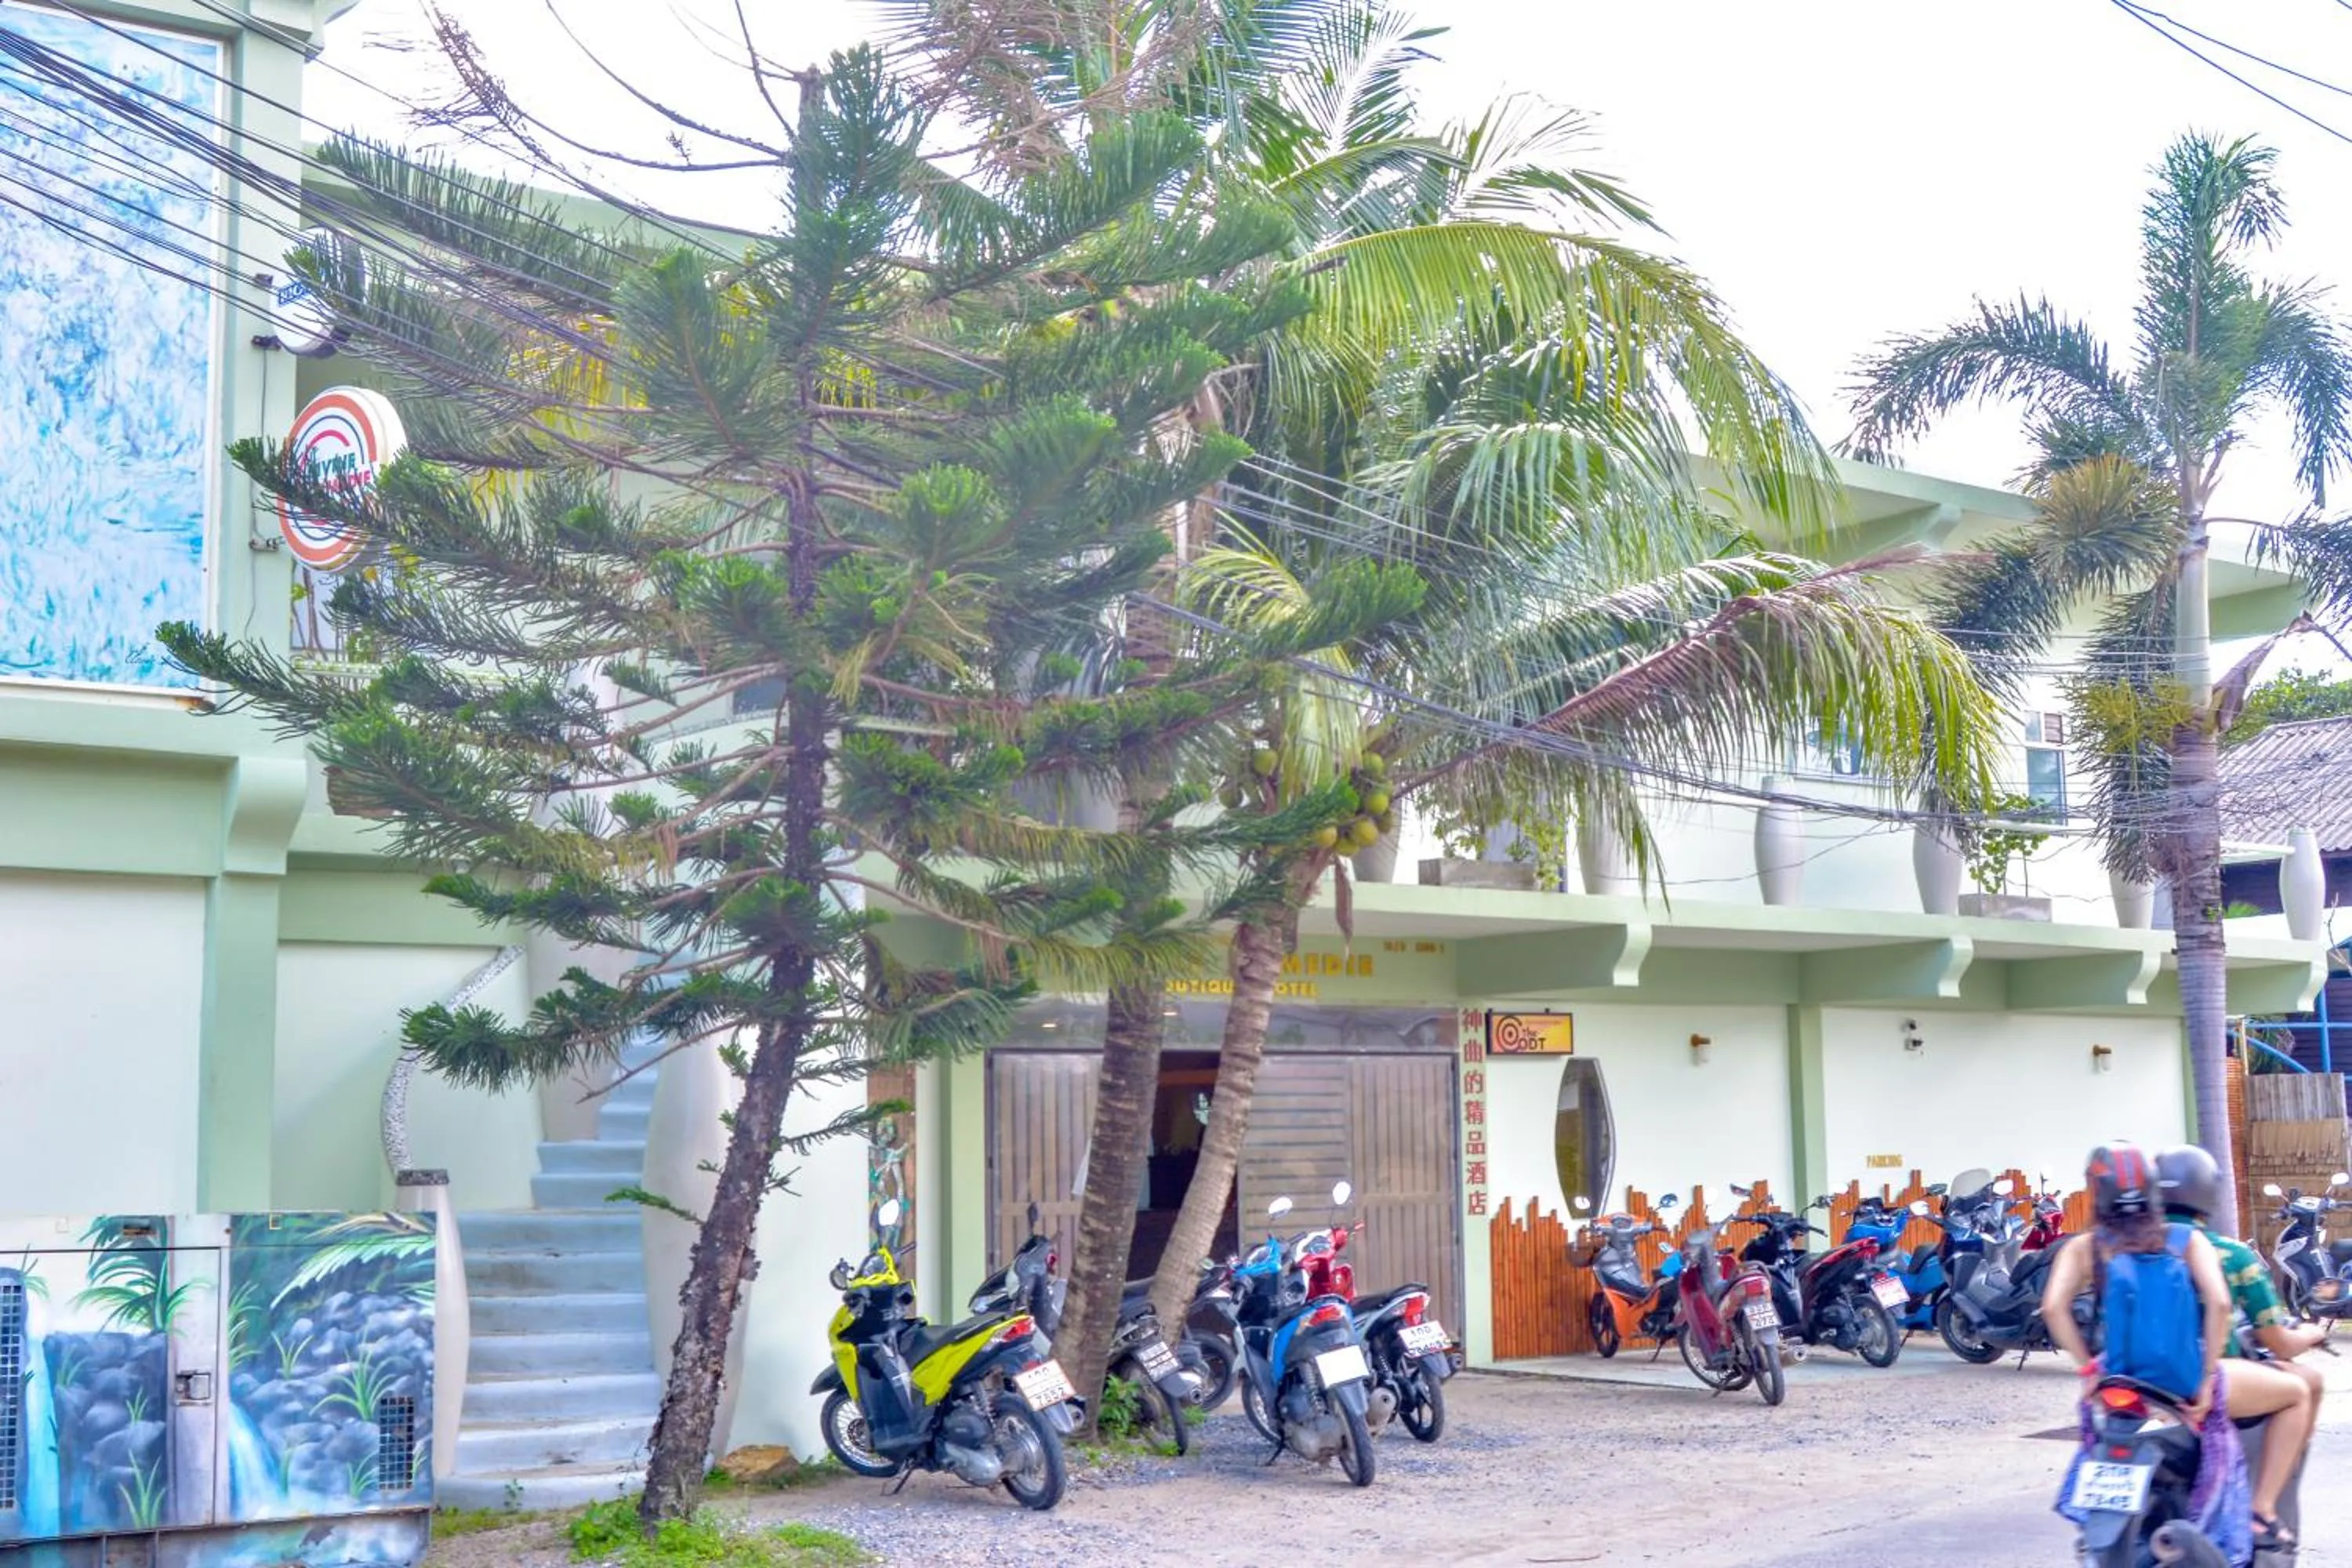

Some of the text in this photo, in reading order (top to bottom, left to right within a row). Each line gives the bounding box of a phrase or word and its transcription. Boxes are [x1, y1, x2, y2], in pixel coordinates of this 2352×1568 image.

[1281, 951, 1374, 977] MEDIE
[1274, 982, 1319, 996] OTEL
[1461, 1007, 1486, 1215] 神曲的精品酒店
[1866, 1155, 1903, 1168] PARKING
